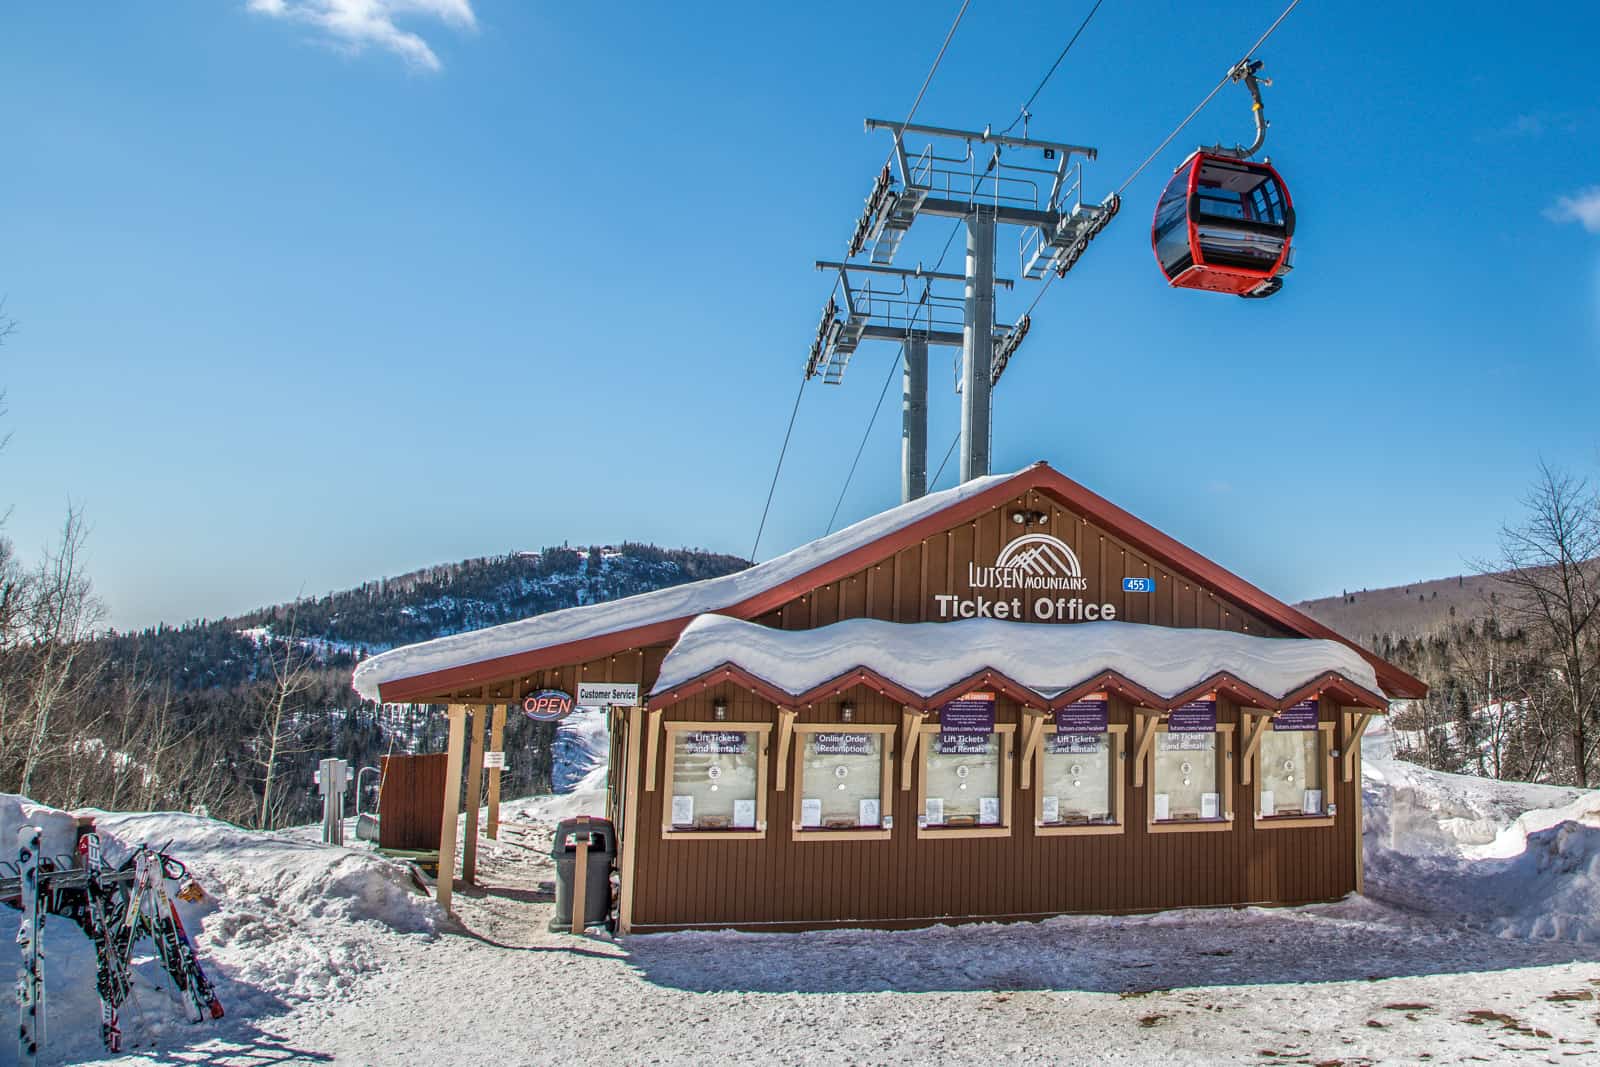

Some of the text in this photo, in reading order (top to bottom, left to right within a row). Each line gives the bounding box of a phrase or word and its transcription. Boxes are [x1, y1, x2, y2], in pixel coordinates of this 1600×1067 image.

[968, 561, 1087, 590] LUTSEN MOUNTAINS
[1127, 579, 1144, 590] 455
[934, 595, 1116, 620] Ticket Office
[580, 688, 636, 699] Customer Service
[524, 697, 572, 713] OPEN
[711, 734, 739, 742] Tickets
[845, 735, 866, 743] Order
[943, 735, 984, 743] Lift Tickets
[1056, 735, 1095, 743] Lift Tickets
[694, 744, 708, 752] and
[820, 744, 865, 753] Redemption
[942, 745, 984, 753] and Rentals
[1056, 745, 1069, 753] and
